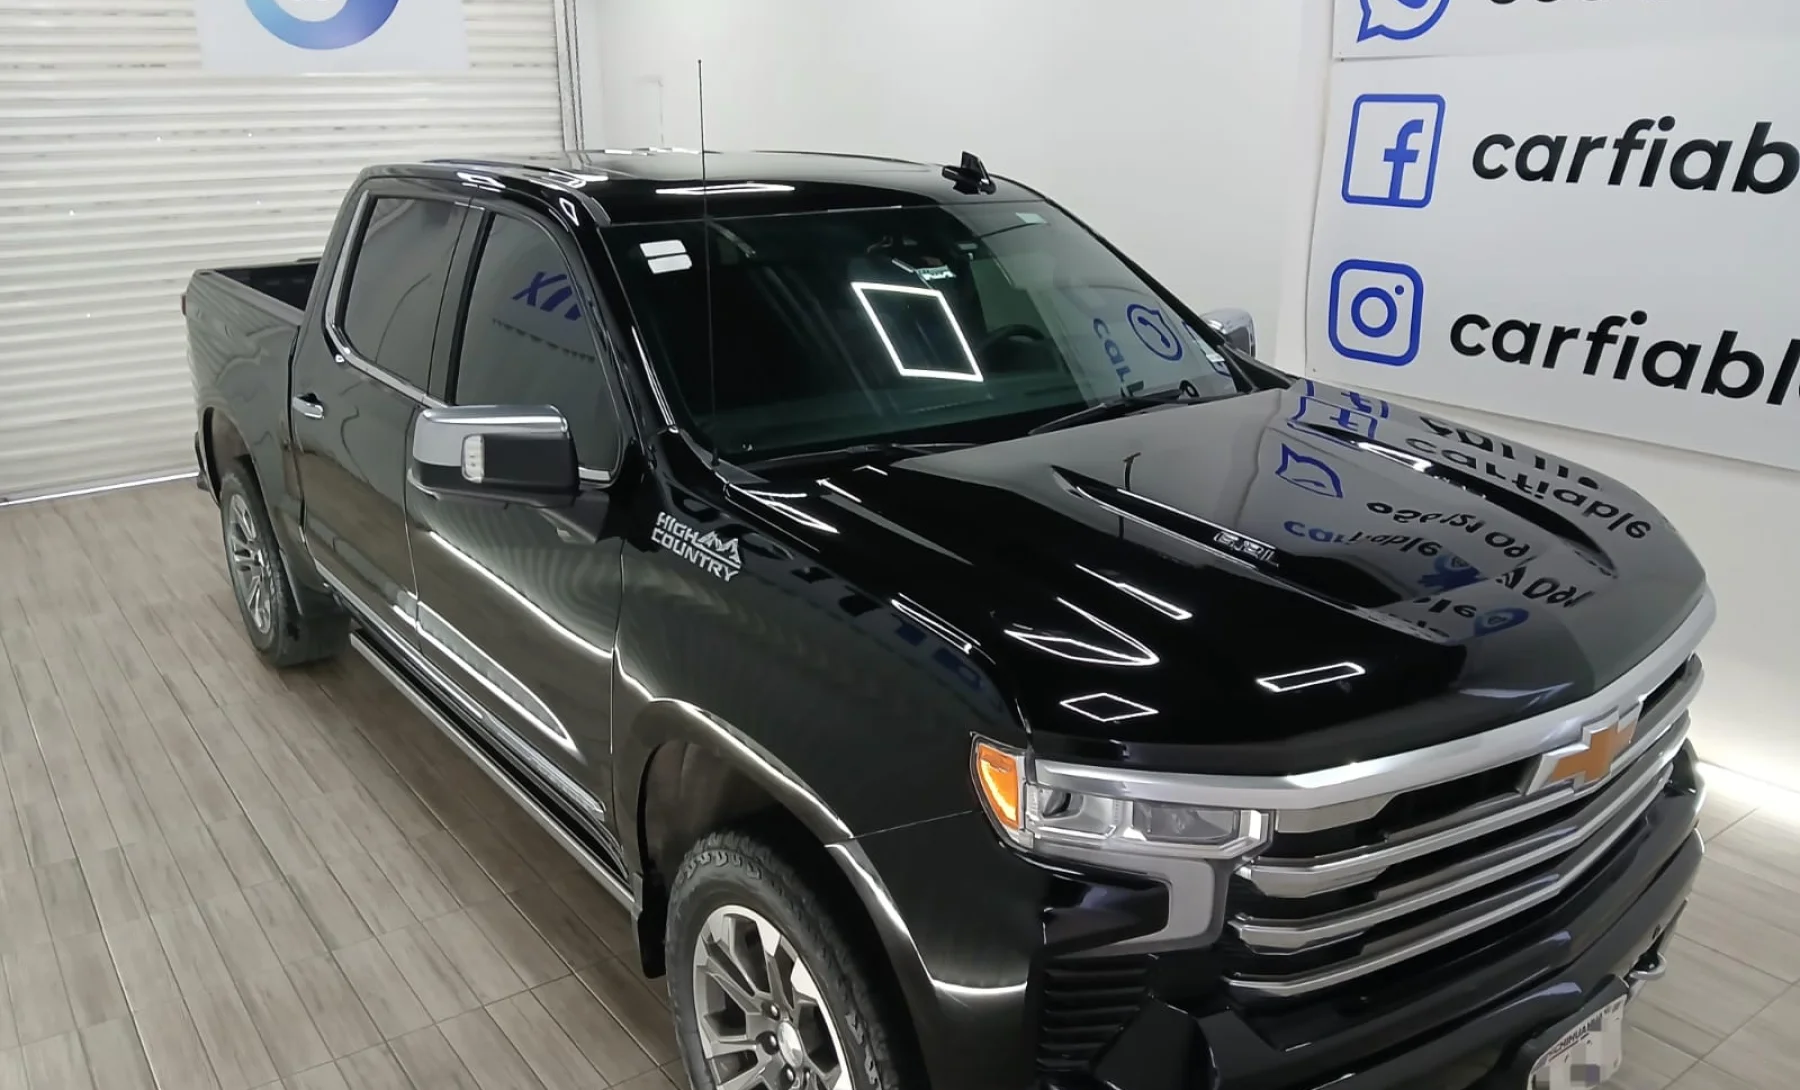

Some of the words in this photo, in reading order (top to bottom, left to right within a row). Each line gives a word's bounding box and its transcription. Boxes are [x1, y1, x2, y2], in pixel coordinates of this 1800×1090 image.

[1450, 310, 1800, 406] carfiabl
[651, 527, 740, 582] COUNTRY
[656, 512, 700, 546] HIGH
